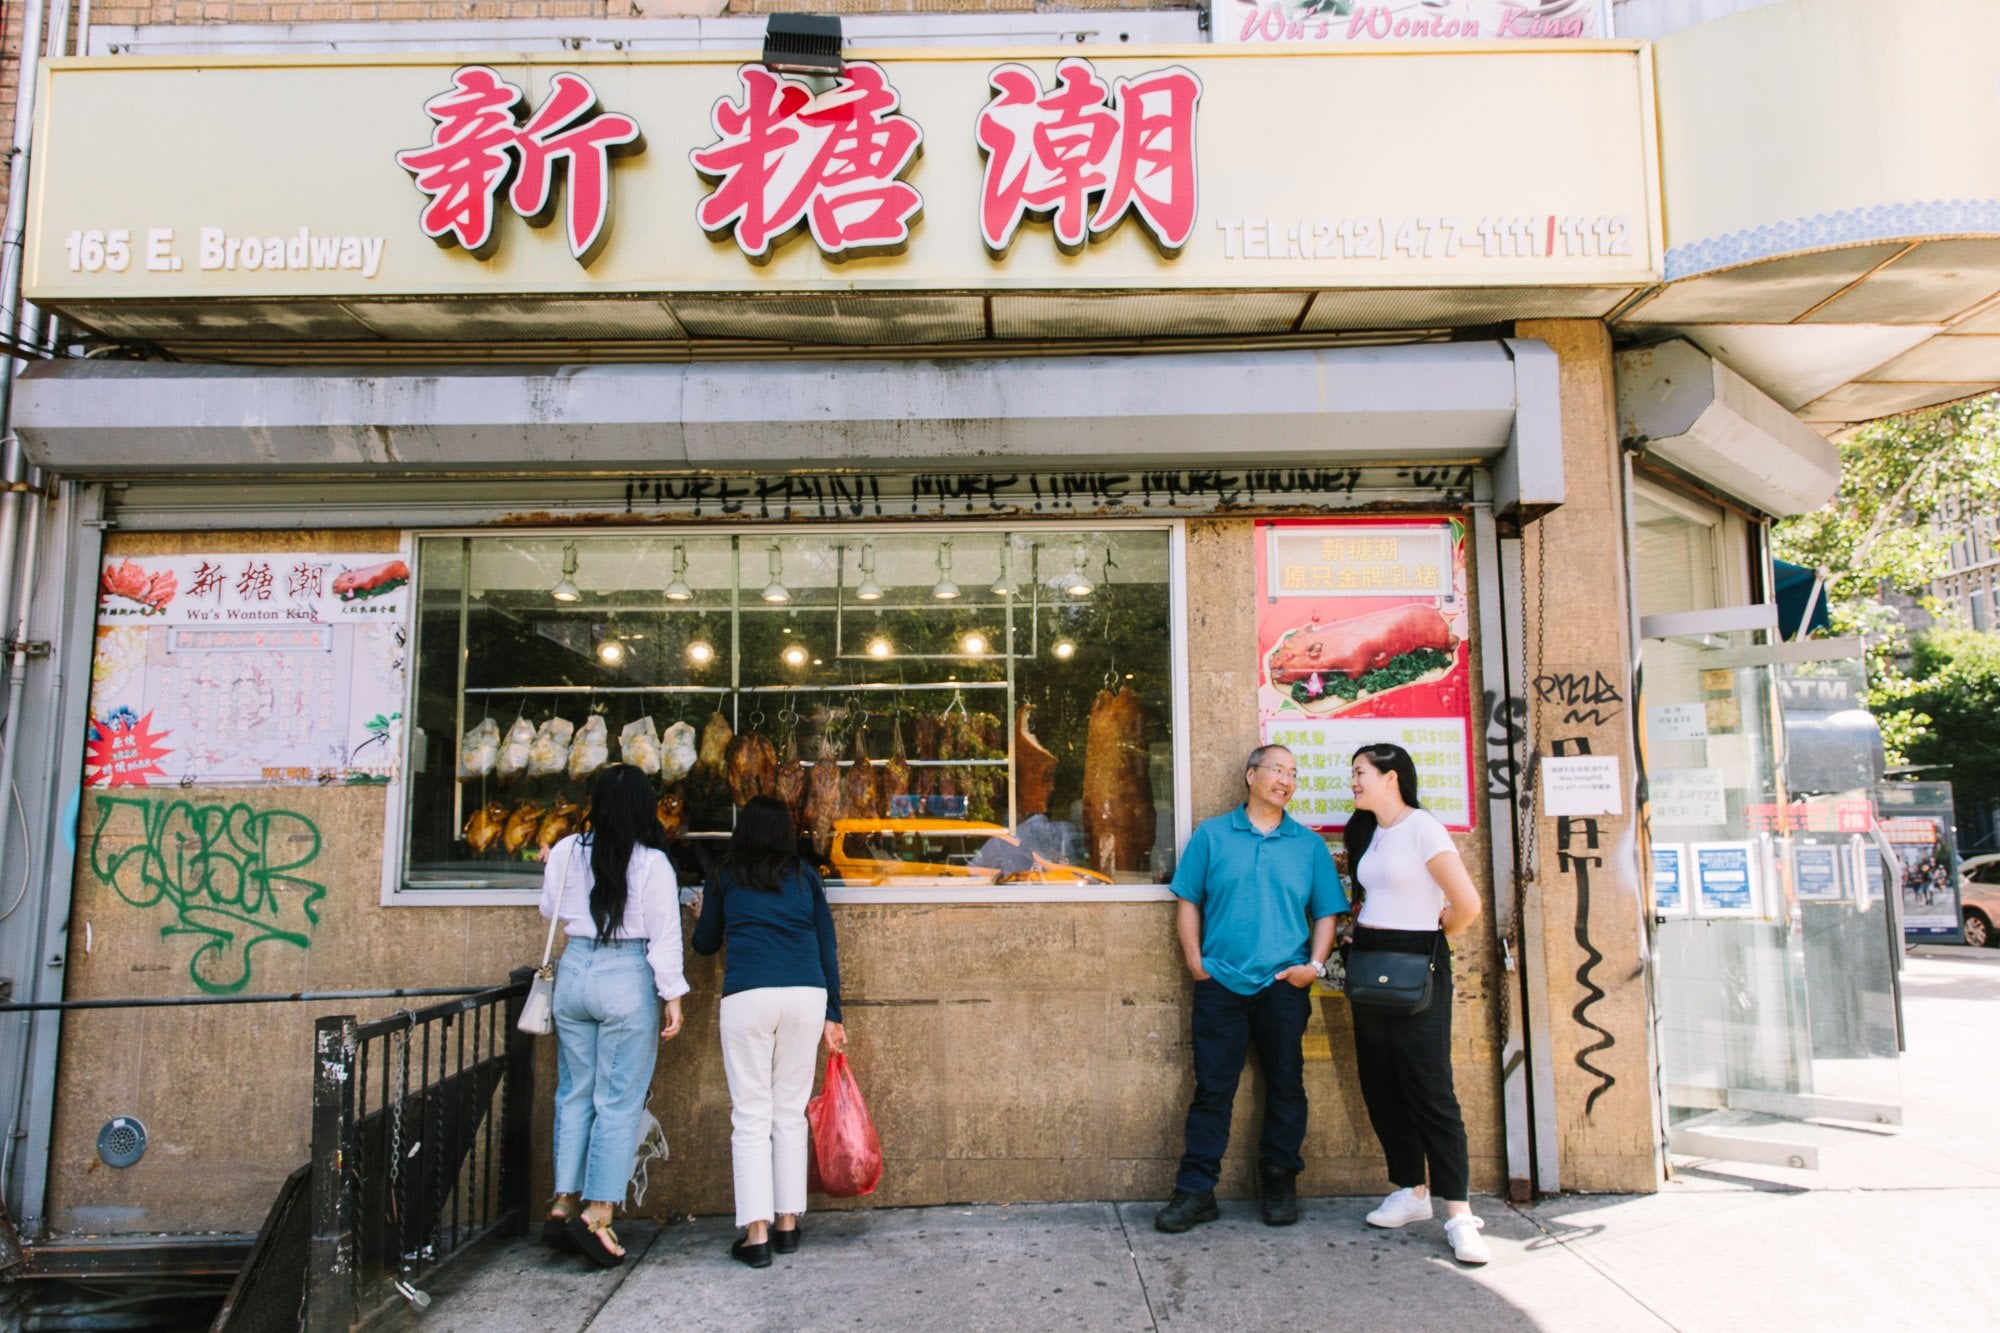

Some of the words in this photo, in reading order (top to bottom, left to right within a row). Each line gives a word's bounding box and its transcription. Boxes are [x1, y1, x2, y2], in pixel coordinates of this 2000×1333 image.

[1240, 7, 1328, 41] Wu's
[1346, 6, 1480, 40] Wonton
[1496, 6, 1584, 40] King
[396, 57, 1204, 267] 新糖潮
[65, 229, 132, 272] 165
[147, 227, 184, 272] E.
[200, 225, 386, 279] Broadway
[1322, 538, 1399, 561] 新糖潮
[186, 560, 325, 605] 新糖潮
[187, 609, 220, 620] Wu's
[227, 608, 279, 620] Wonton
[286, 608, 319, 622] King
